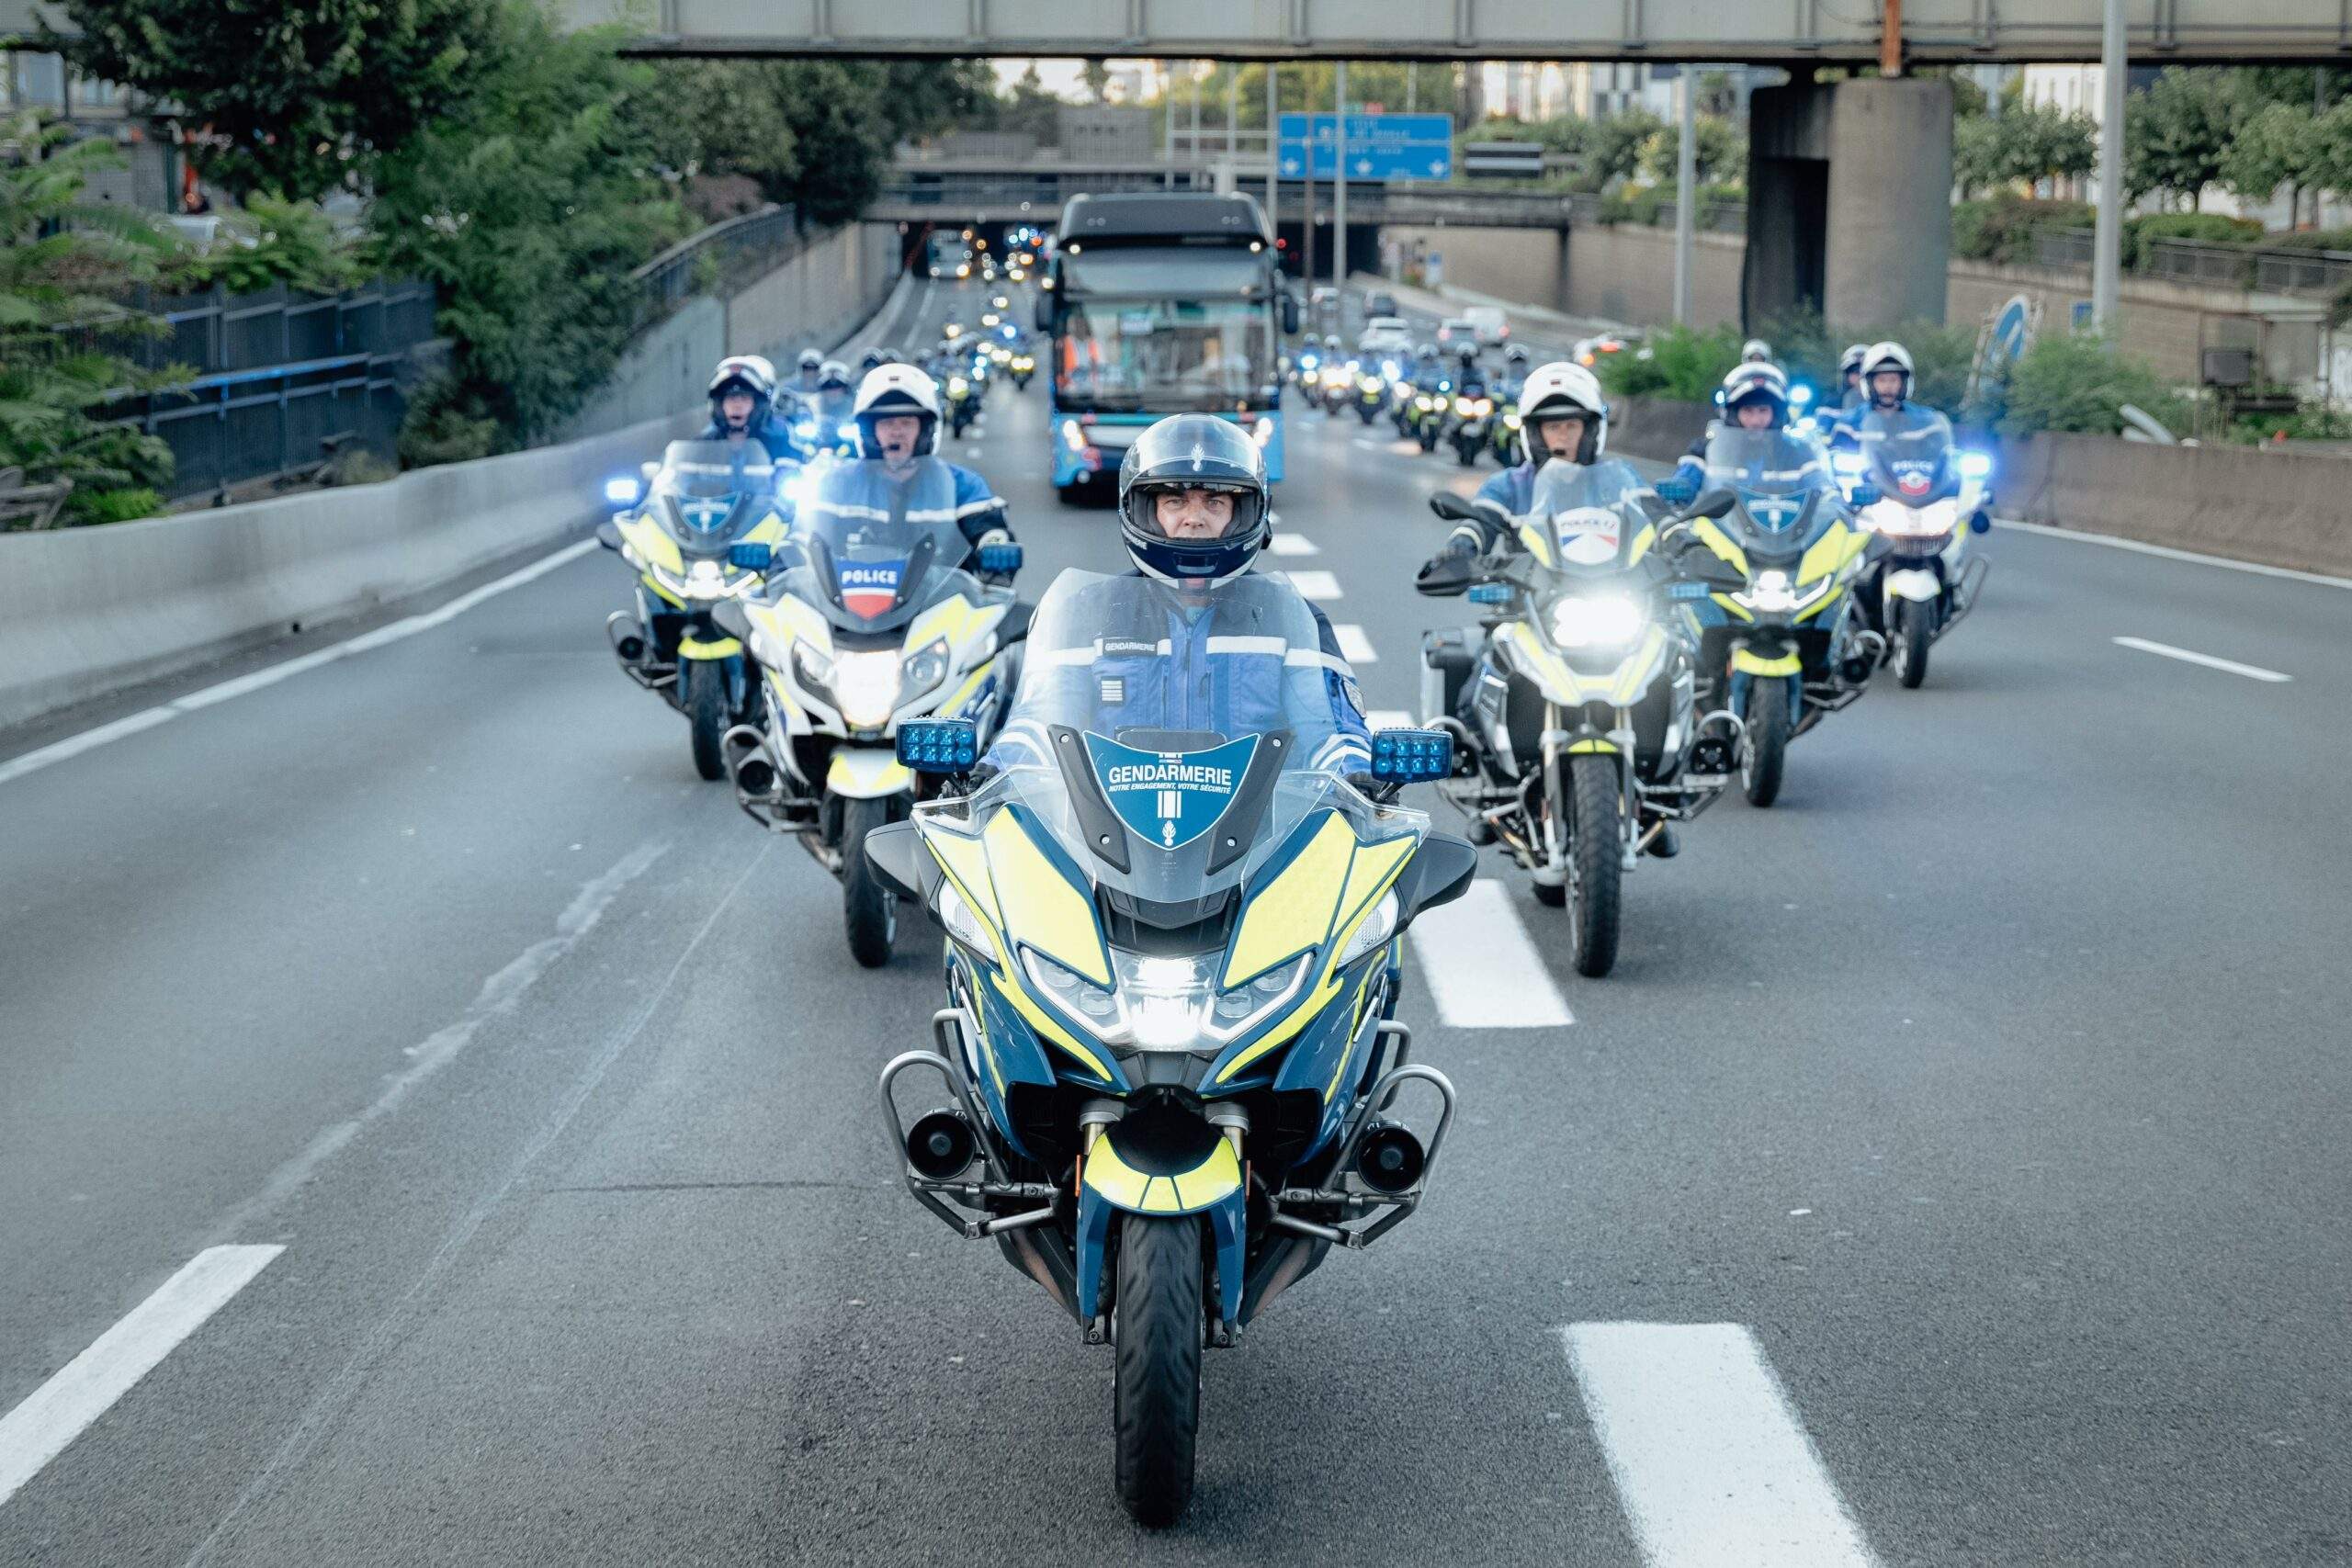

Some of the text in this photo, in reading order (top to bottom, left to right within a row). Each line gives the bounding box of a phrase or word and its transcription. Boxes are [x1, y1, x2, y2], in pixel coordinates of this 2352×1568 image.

[842, 570, 897, 584] POLICE
[1108, 764, 1231, 785] GENDARMERIE
[1108, 784, 1130, 792] NOTRE
[1178, 783, 1200, 791] VOTRE
[1200, 784, 1231, 795] SÉCURITÉ
